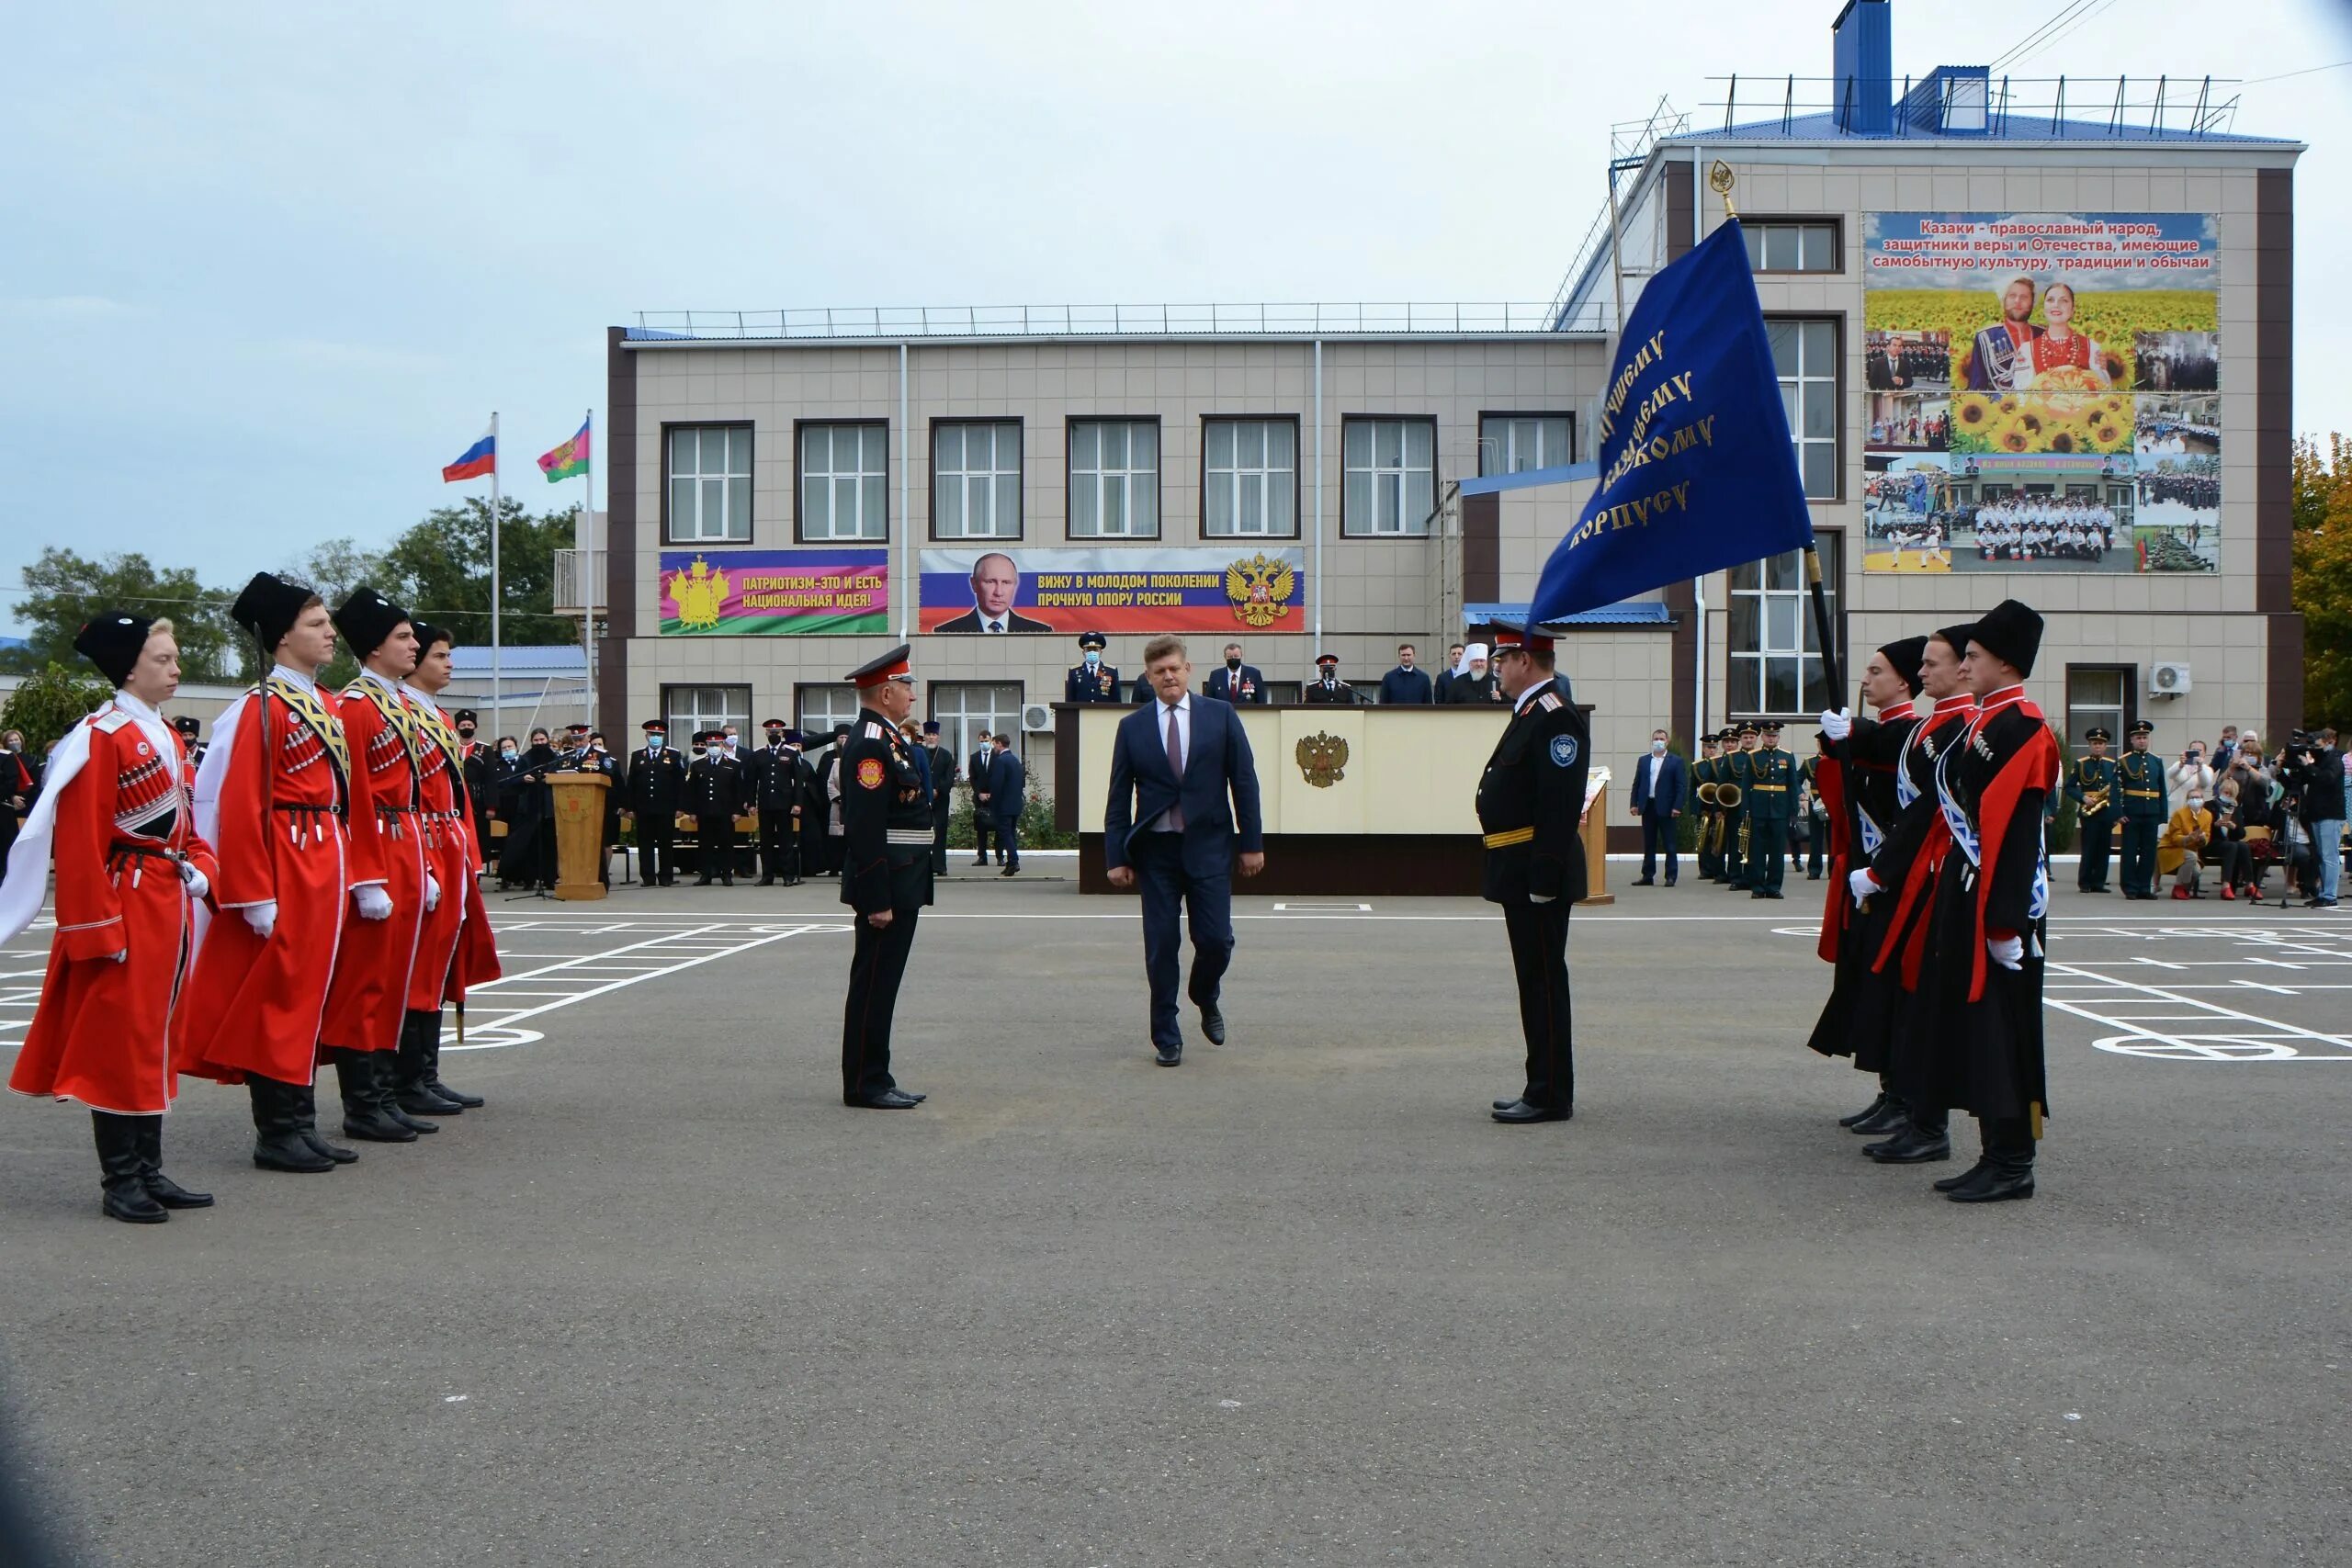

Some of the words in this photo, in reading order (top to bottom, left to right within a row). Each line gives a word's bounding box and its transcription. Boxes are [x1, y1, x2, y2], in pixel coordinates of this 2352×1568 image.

[1920, 220, 1974, 234] Казаки
[1989, 220, 2103, 237] православный
[2108, 223, 2161, 237] народ,
[1883, 240, 1970, 253] защитники
[1975, 241, 2013, 254] веры
[2018, 241, 2028, 251] и
[2031, 238, 2118, 254] Отечества,
[2121, 241, 2199, 254] имеющие
[1872, 254, 1975, 270] самобытную
[1979, 257, 2052, 271] культуру,
[2056, 258, 2132, 271] традиции
[2136, 258, 2146, 268] и
[2150, 254, 2210, 268] обычаи
[843, 576, 852, 590] И
[855, 575, 882, 590] ЕСТЬ
[1037, 574, 1072, 589] ВИЖУ
[1076, 574, 1083, 588] В
[1087, 574, 1148, 591] МОЛОДОМ
[1150, 574, 1220, 589] ПОКОЛЕНИИ
[742, 593, 833, 610] НАЦИОНАЛЬНАЯ
[836, 592, 872, 609] ИДЕЯ!
[1037, 592, 1093, 606] ПРОЧНУЮ
[1096, 592, 1134, 606] ОПОРУ
[1136, 592, 1183, 606] РОССИИ
